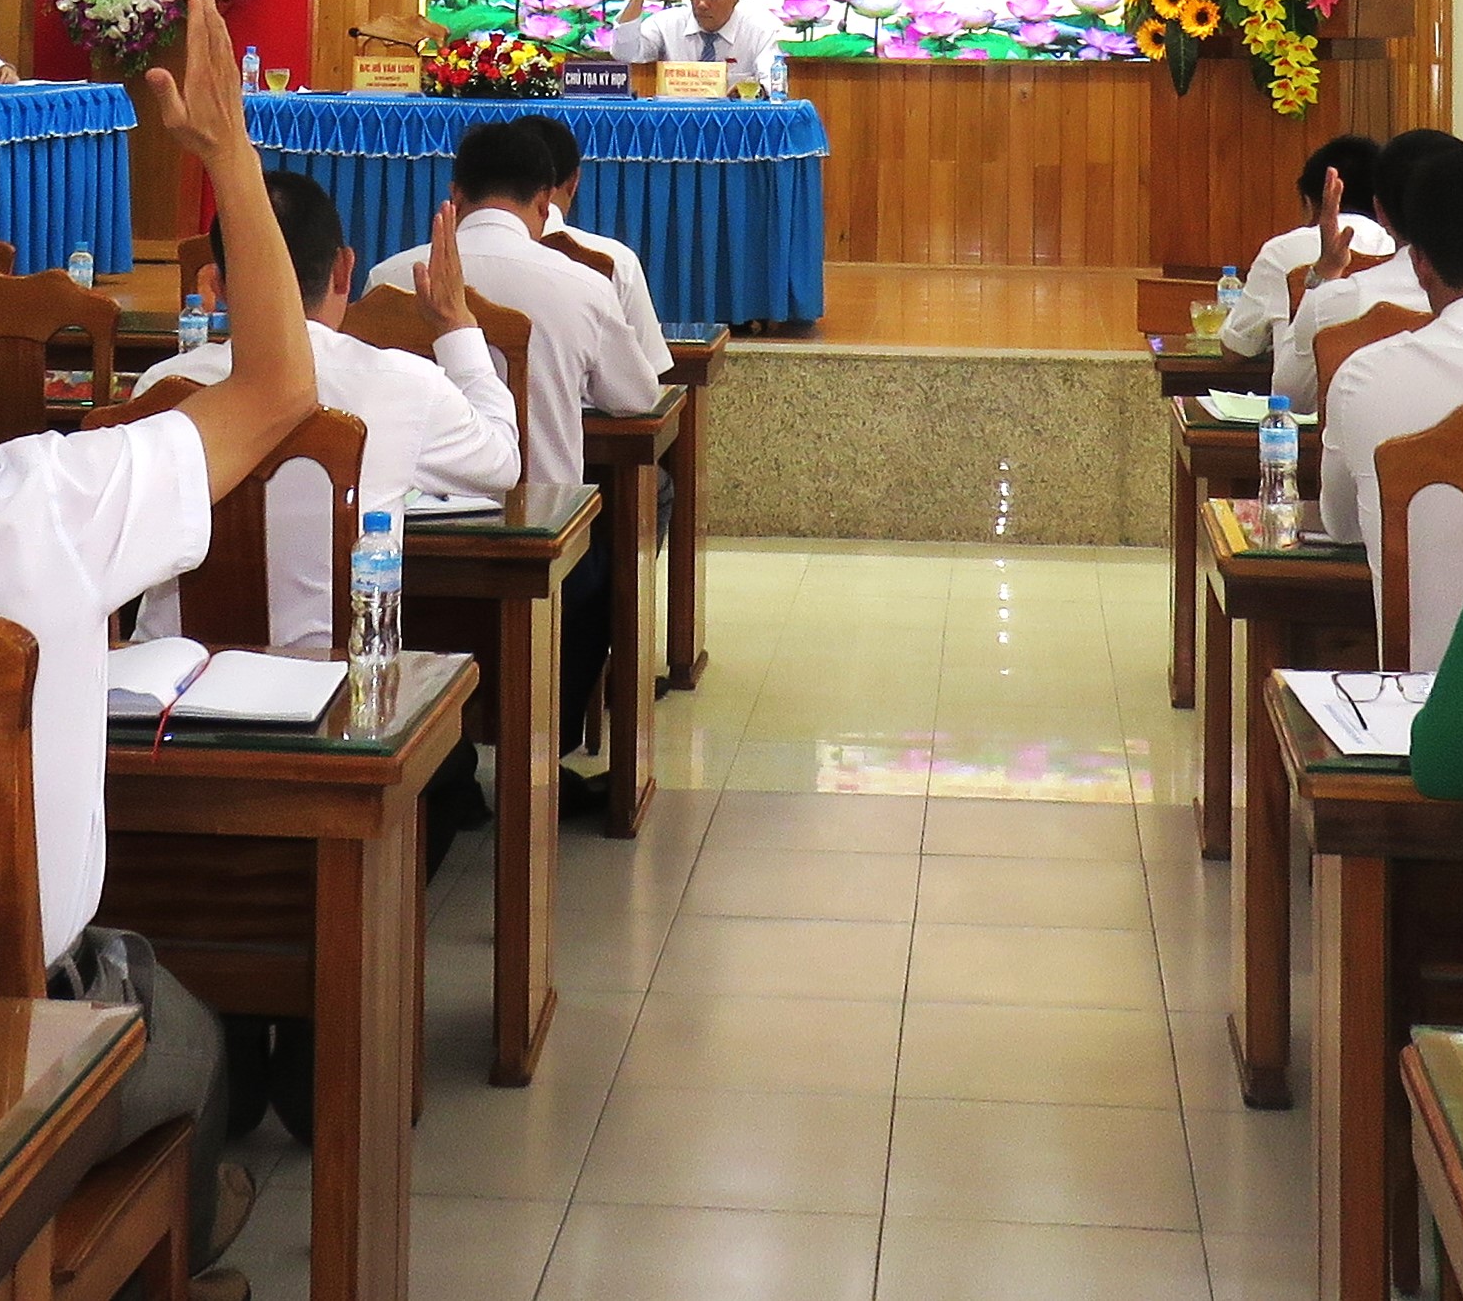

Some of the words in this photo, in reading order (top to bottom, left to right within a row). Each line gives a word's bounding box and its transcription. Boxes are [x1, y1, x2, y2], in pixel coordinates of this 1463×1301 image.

[565, 68, 582, 86] CHỦ
[582, 72, 598, 88] TỌA
[599, 70, 610, 86] KỲ
[611, 73, 628, 89] HỌP
